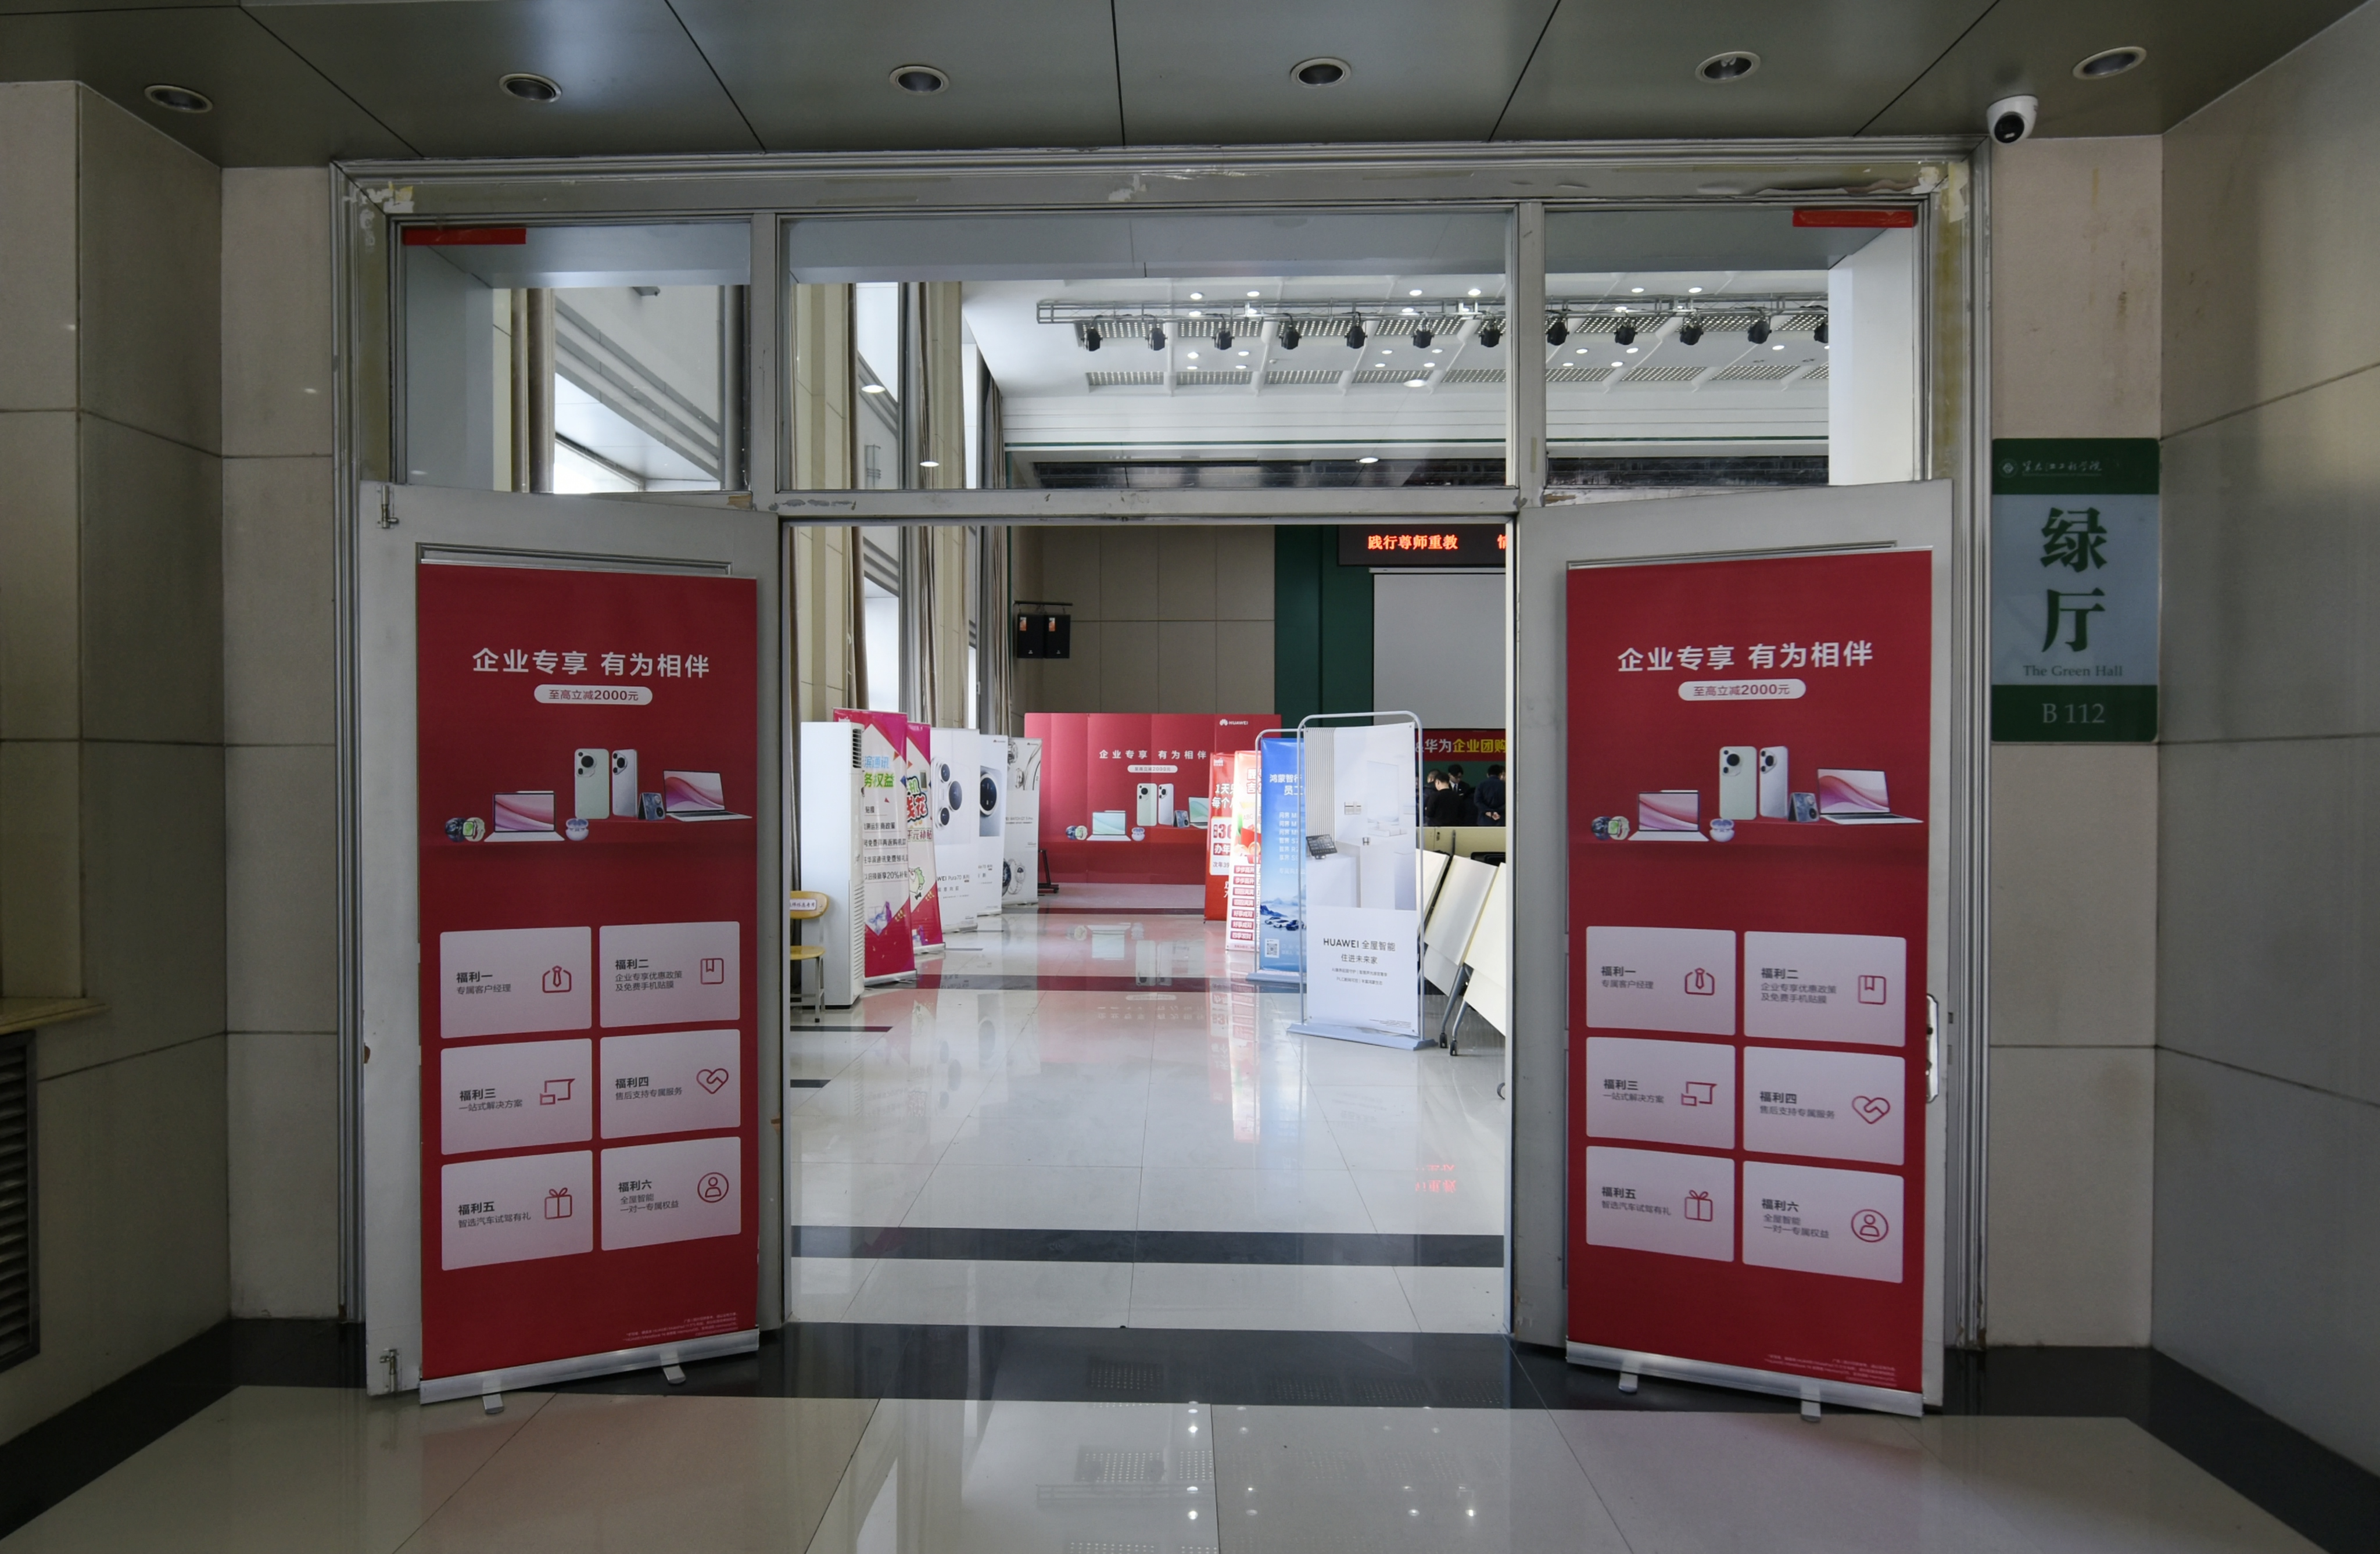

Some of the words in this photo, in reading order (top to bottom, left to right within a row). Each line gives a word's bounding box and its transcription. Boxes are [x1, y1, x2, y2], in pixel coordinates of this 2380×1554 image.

[1368, 535, 1458, 550] 践行尊师重教
[2040, 507, 2107, 652] 绿厅
[473, 647, 587, 674] 企业专享
[601, 651, 709, 678] 有为相伴
[1618, 644, 1734, 672] 企业专享
[1748, 640, 1873, 669] 有为相伴
[2023, 665, 2047, 677] The
[2051, 665, 2090, 677] Green
[2095, 665, 2123, 677] Hall
[549, 688, 639, 702] 至高立减2000元
[1693, 684, 1790, 697] 至高立减2000元
[2042, 703, 2058, 724] B
[2066, 703, 2106, 724] 112
[1099, 750, 1148, 760] 企业专享
[1158, 750, 1207, 760] 有为相伴
[1324, 938, 1359, 948] HUAWEI
[1361, 940, 1396, 951] 全屋智能
[615, 959, 648, 971] 福利二
[1341, 954, 1378, 964] 住进未来家
[456, 971, 493, 983] 福利一
[615, 970, 683, 982] 企业专享优惠政策
[1601, 966, 1636, 977] 福利一
[1761, 968, 1798, 980] 福利二
[456, 983, 511, 995] 专属客户经理
[615, 980, 675, 992] 及免费手机贴膜
[1601, 979, 1654, 990] 专属客户经理
[1761, 982, 1837, 994] 企业专享优惠政策
[1761, 993, 1827, 1004] 及免费手机贴膜
[615, 1076, 649, 1088] 福利四
[1604, 1079, 1638, 1091] 福利三
[460, 1088, 496, 1101] 福利三
[615, 1087, 683, 1100] 售后支持专属服务
[1603, 1092, 1664, 1104] 一站式解决方案
[1760, 1091, 1797, 1104] 福利四
[458, 1099, 522, 1112] 一站式解决方案
[1760, 1105, 1835, 1119] 售后支持专属服务
[618, 1179, 652, 1193] 福利六
[1601, 1186, 1636, 1199] 福利五
[621, 1193, 654, 1205] 全屋智能
[1762, 1198, 1799, 1212] 福利六
[458, 1201, 495, 1216] 福利五
[620, 1199, 679, 1213] 一对一专属权益
[1601, 1200, 1672, 1216] 智选汽车试驾有礼
[458, 1212, 531, 1229] 智选汽车试驾有礼
[1764, 1213, 1801, 1226] 全屋智能
[1764, 1224, 1829, 1239] 一对一专属权益
